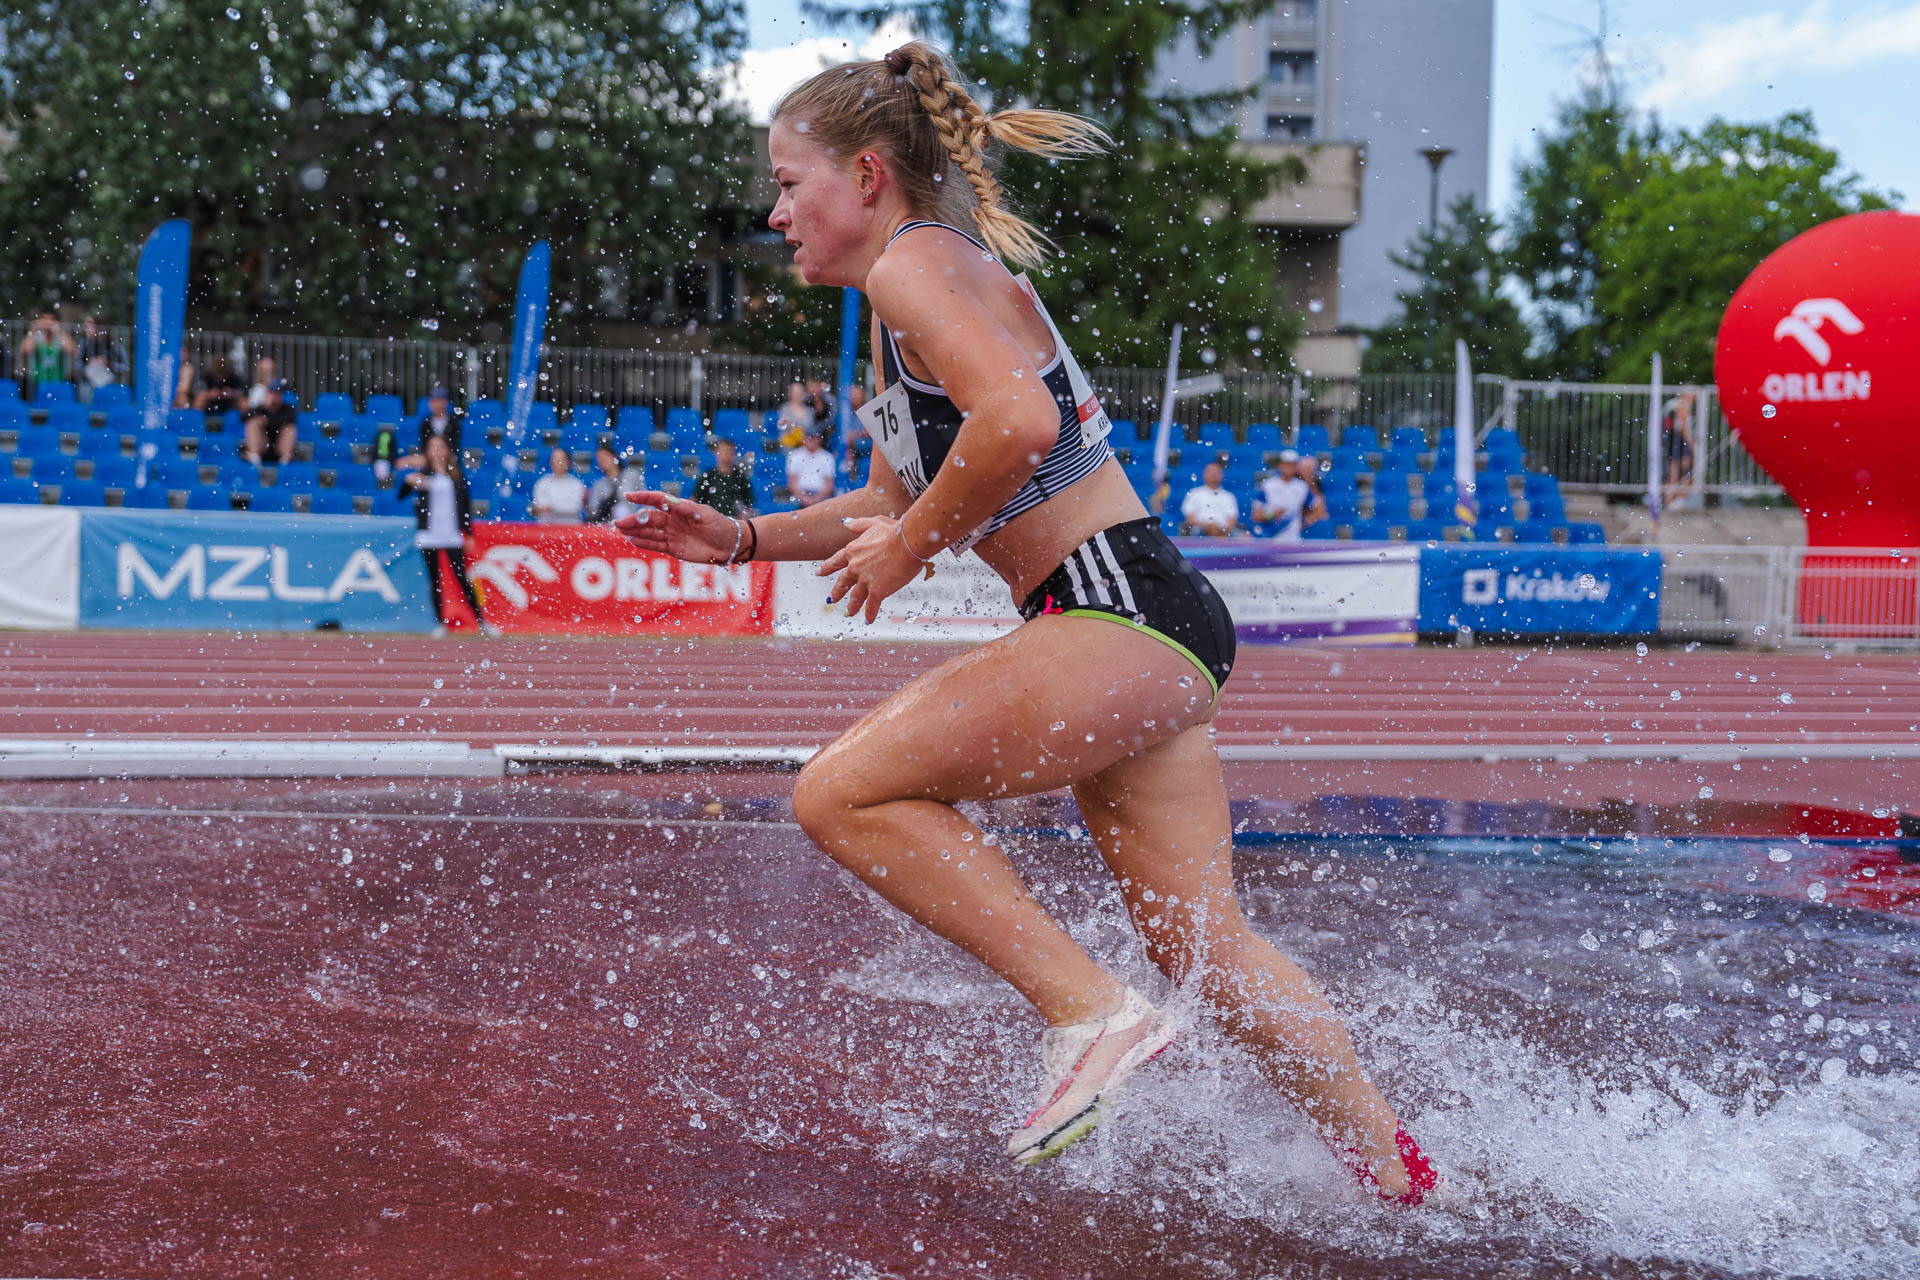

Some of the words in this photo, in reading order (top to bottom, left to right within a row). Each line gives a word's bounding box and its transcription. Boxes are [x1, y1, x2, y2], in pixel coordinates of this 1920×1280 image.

[1763, 370, 1871, 403] ORLEN
[873, 400, 898, 442] 76
[117, 542, 401, 602] MZLA
[570, 556, 750, 602] ORLEN
[1505, 571, 1611, 602] Kraków
